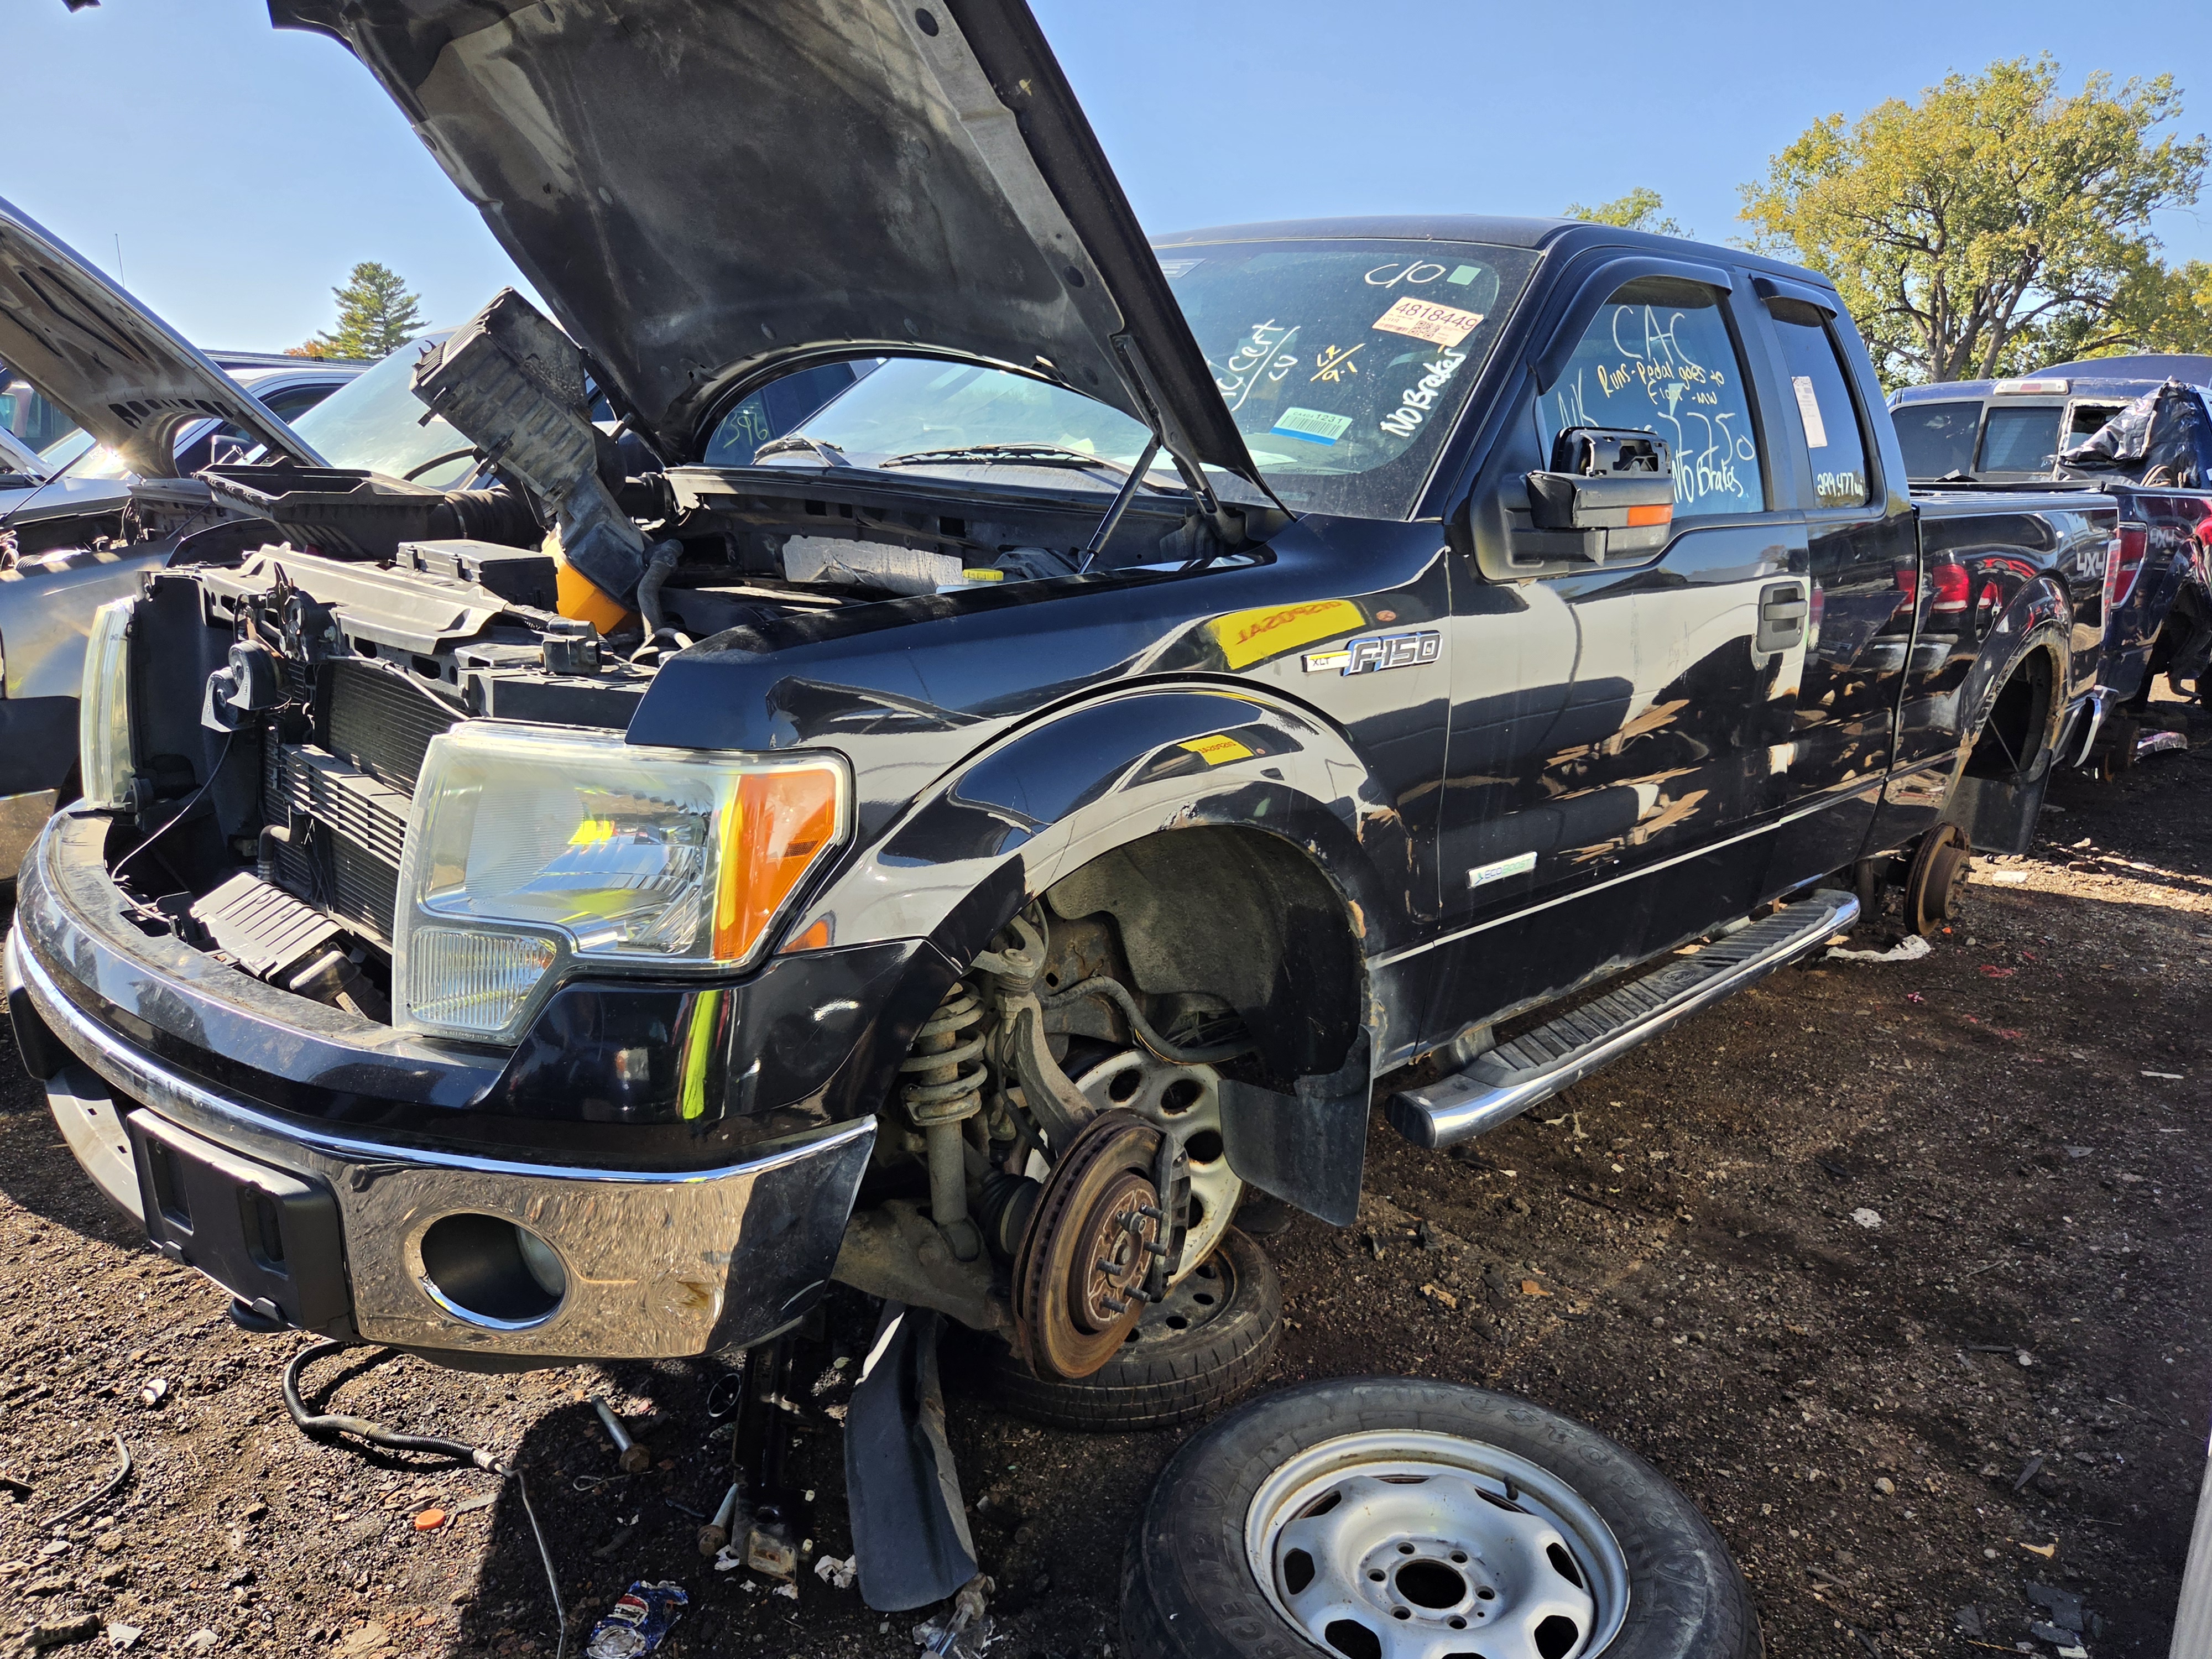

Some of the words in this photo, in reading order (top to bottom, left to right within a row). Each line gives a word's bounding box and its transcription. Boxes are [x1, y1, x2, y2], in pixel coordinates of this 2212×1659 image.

[1395, 302, 1478, 330] 4818449
[1402, 348, 1467, 410] Brakes
[1678, 366, 1707, 390] goes
[1710, 369, 1725, 387] to
[1696, 456, 1744, 498] Brakes
[1312, 658, 1330, 666] XLT
[1352, 633, 1441, 672] F-150
[1485, 859, 1531, 879] ECOBOOST
